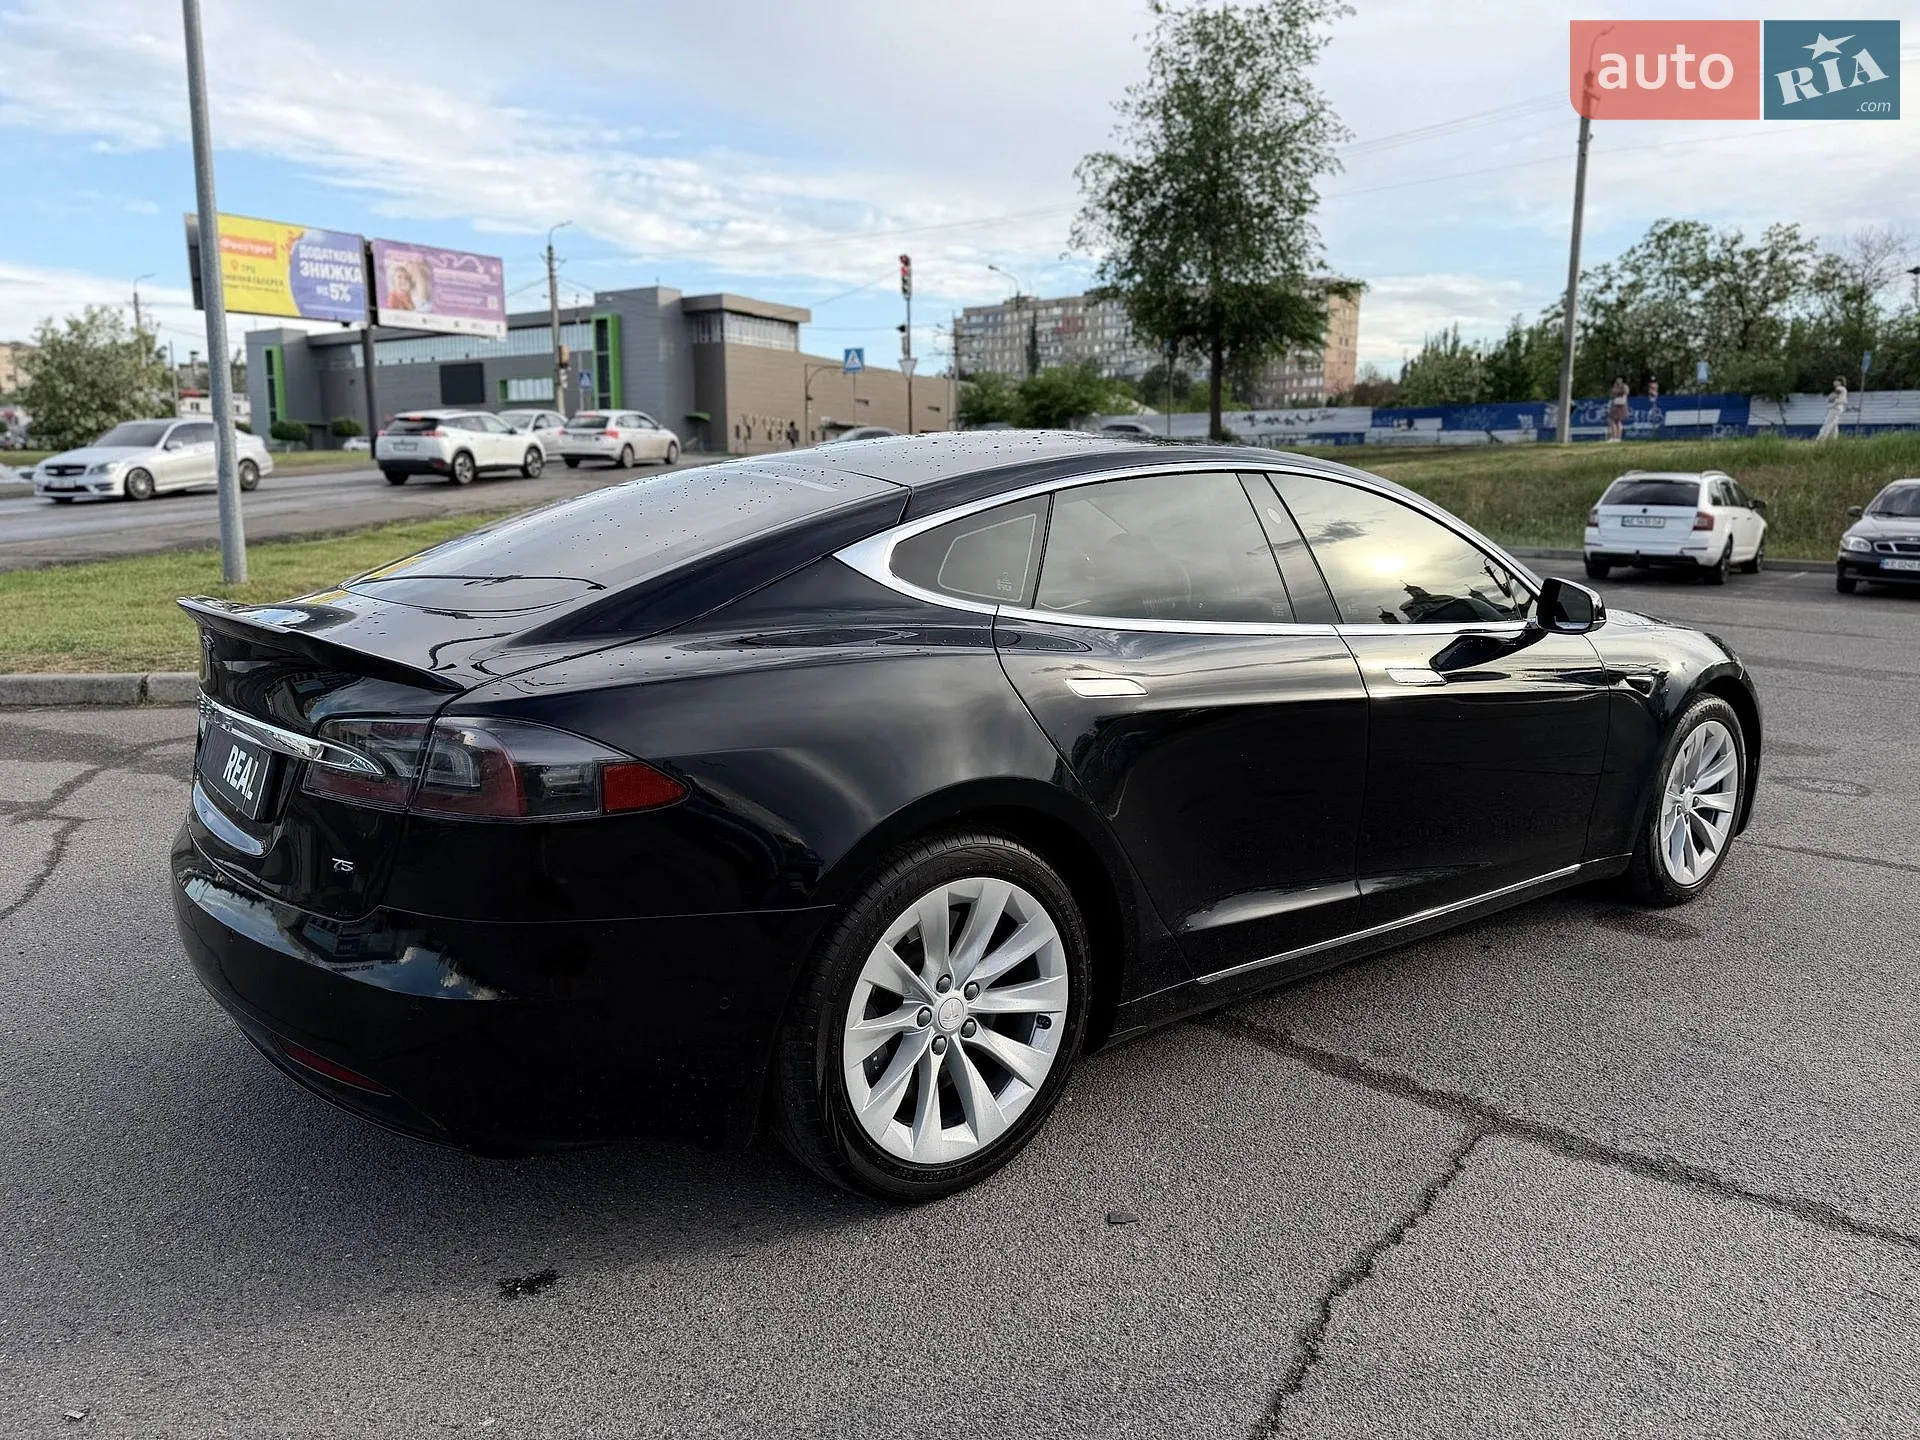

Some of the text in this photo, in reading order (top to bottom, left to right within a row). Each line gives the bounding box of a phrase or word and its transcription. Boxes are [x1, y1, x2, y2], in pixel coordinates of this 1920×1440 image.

[299, 260, 363, 284] ЗНИЖКА
[329, 283, 352, 302] 5%
[222, 744, 259, 801] REAL
[331, 857, 354, 873] 75
